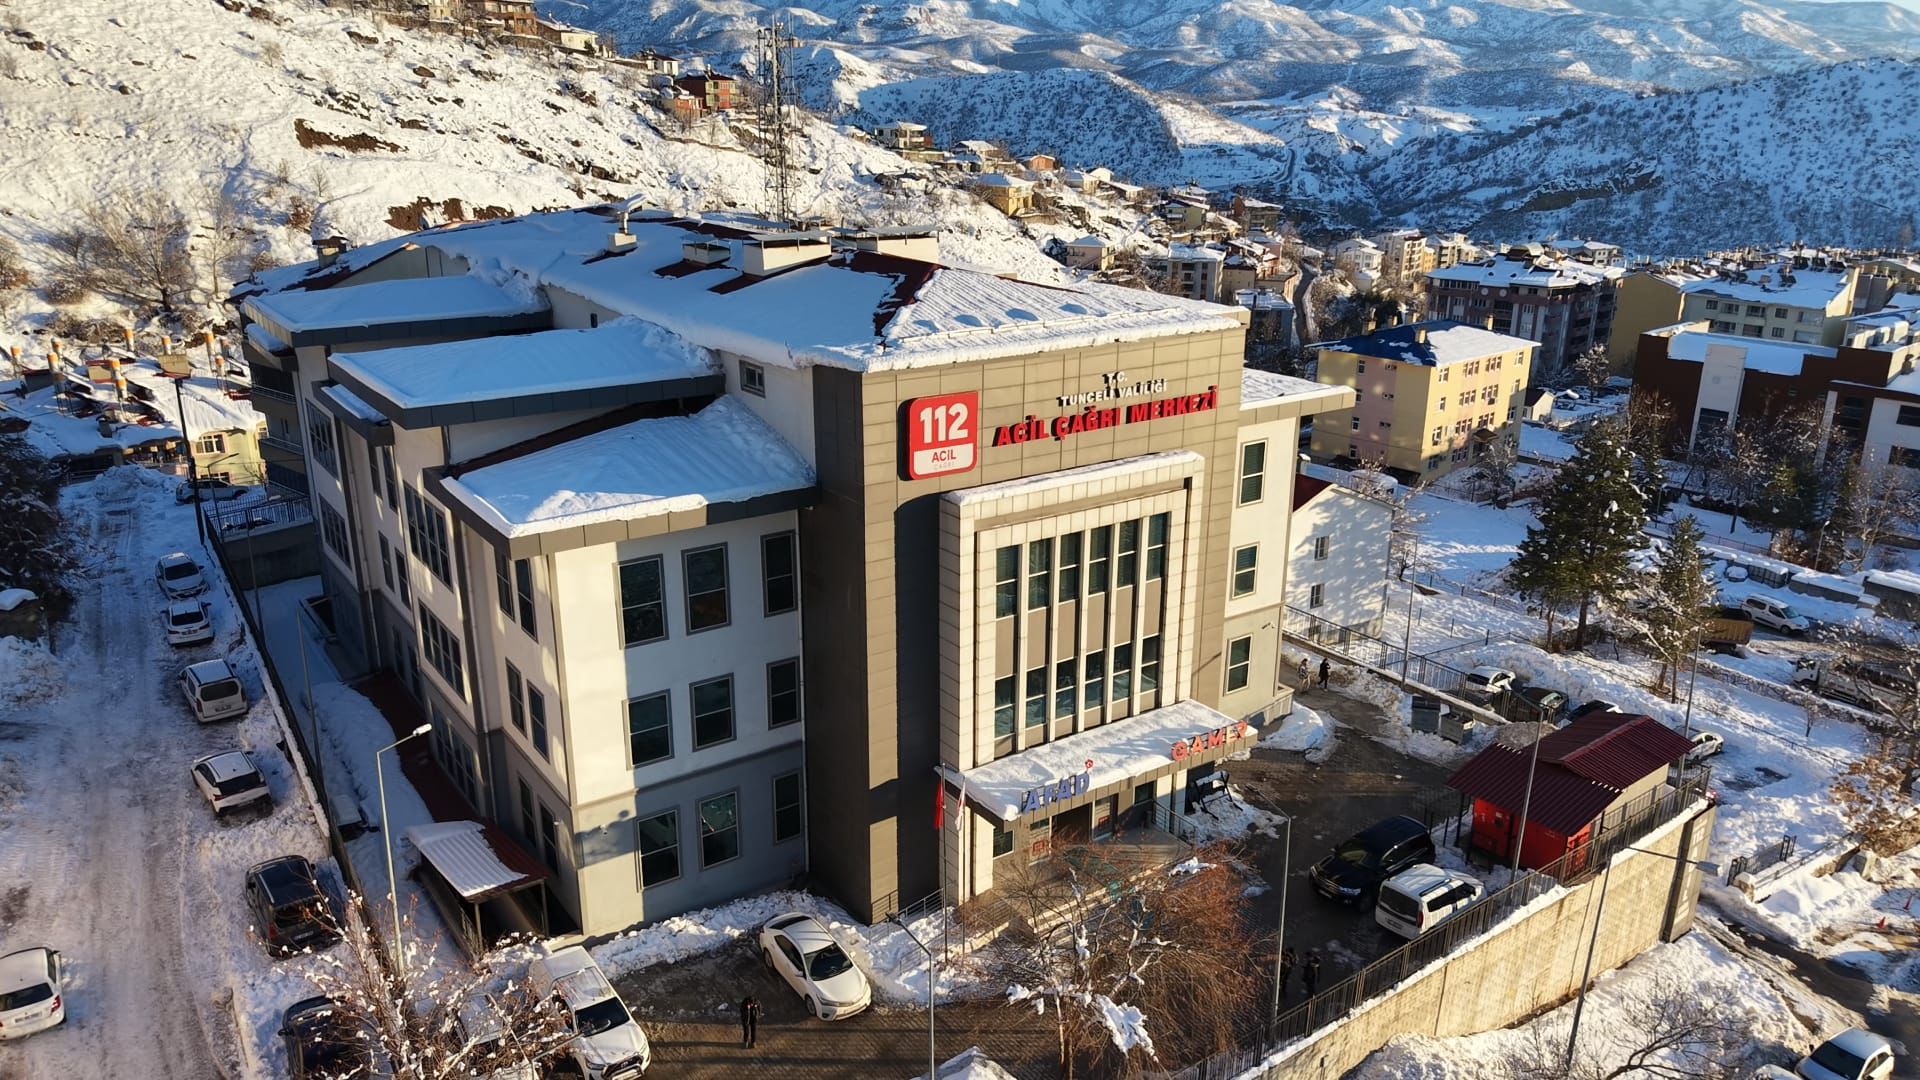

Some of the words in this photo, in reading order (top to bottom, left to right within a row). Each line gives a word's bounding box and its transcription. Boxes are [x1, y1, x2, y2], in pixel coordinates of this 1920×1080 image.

[1106, 371, 1128, 384] T.C.
[1060, 387, 1116, 407] TUNCELİ
[920, 402, 969, 444] 112
[993, 416, 1049, 447] ACİL
[1053, 406, 1121, 440] ÇAĞRI
[1129, 385, 1218, 424] MERKEZİ
